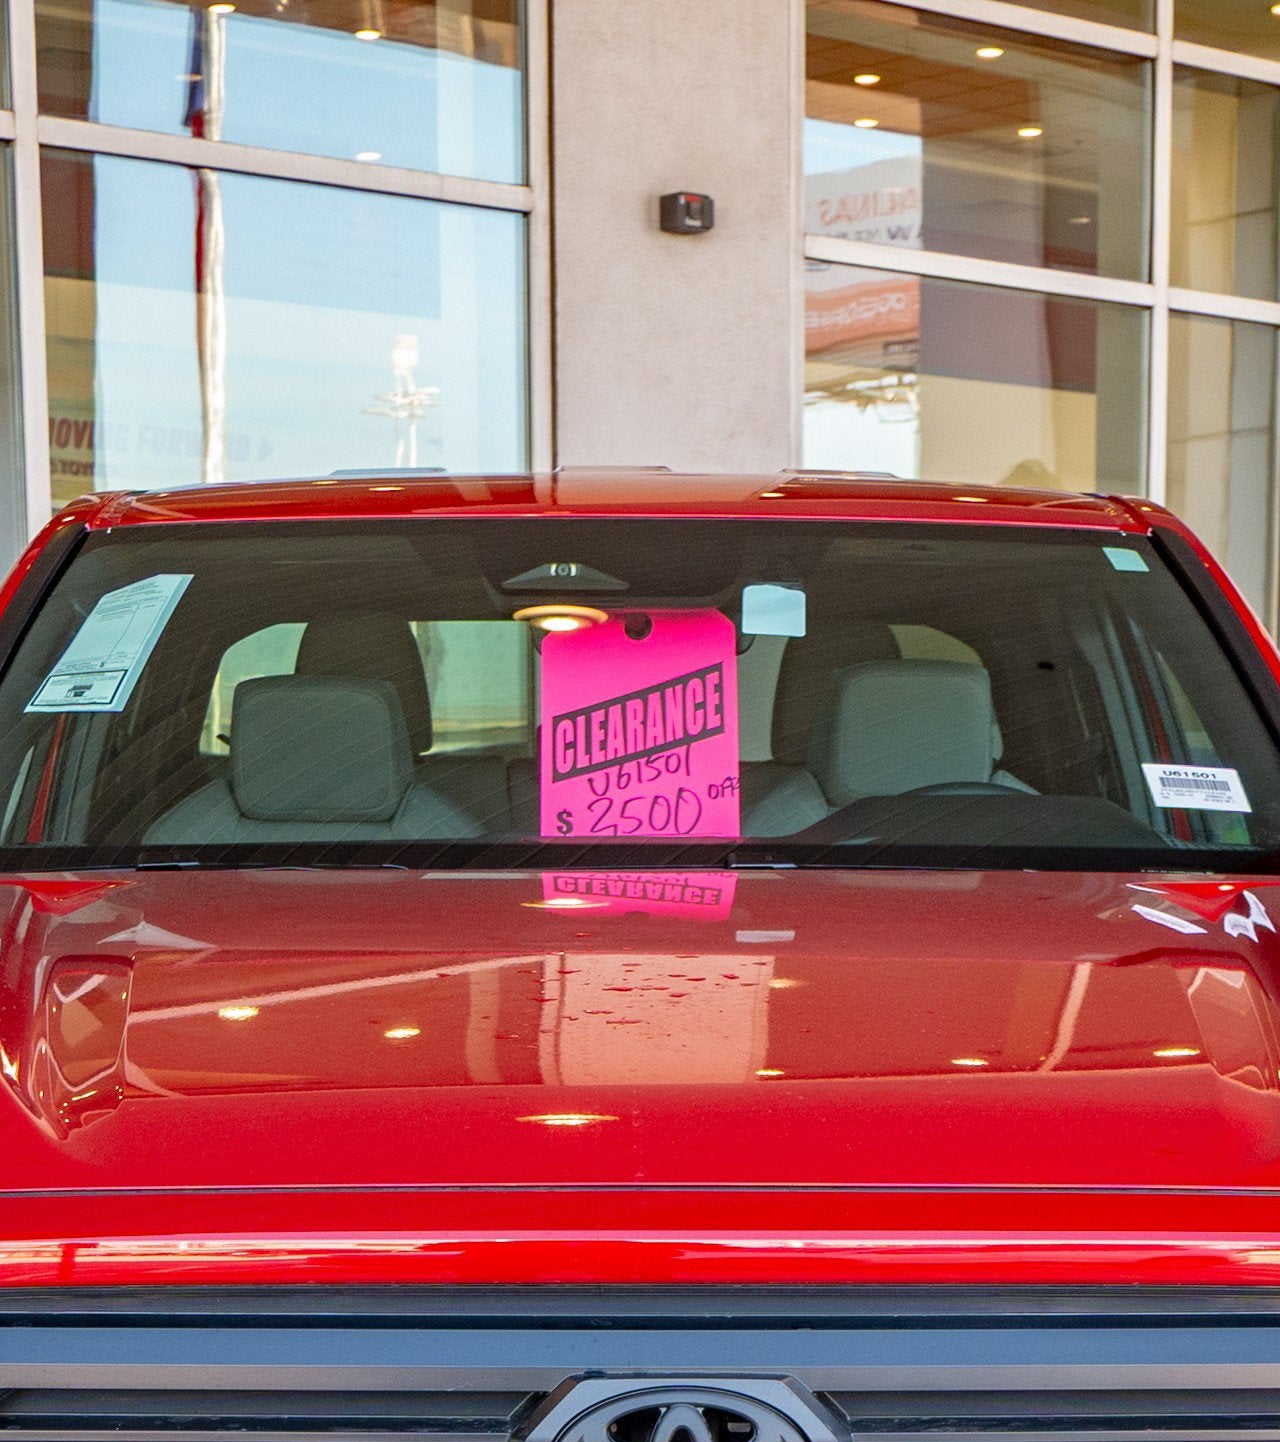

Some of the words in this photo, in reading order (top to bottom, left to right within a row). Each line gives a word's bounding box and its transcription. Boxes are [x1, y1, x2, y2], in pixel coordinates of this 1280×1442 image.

[555, 671, 722, 774] CLEARANCE
[588, 744, 692, 797] U61501
[556, 809, 573, 835] $
[587, 788, 702, 836] 2500
